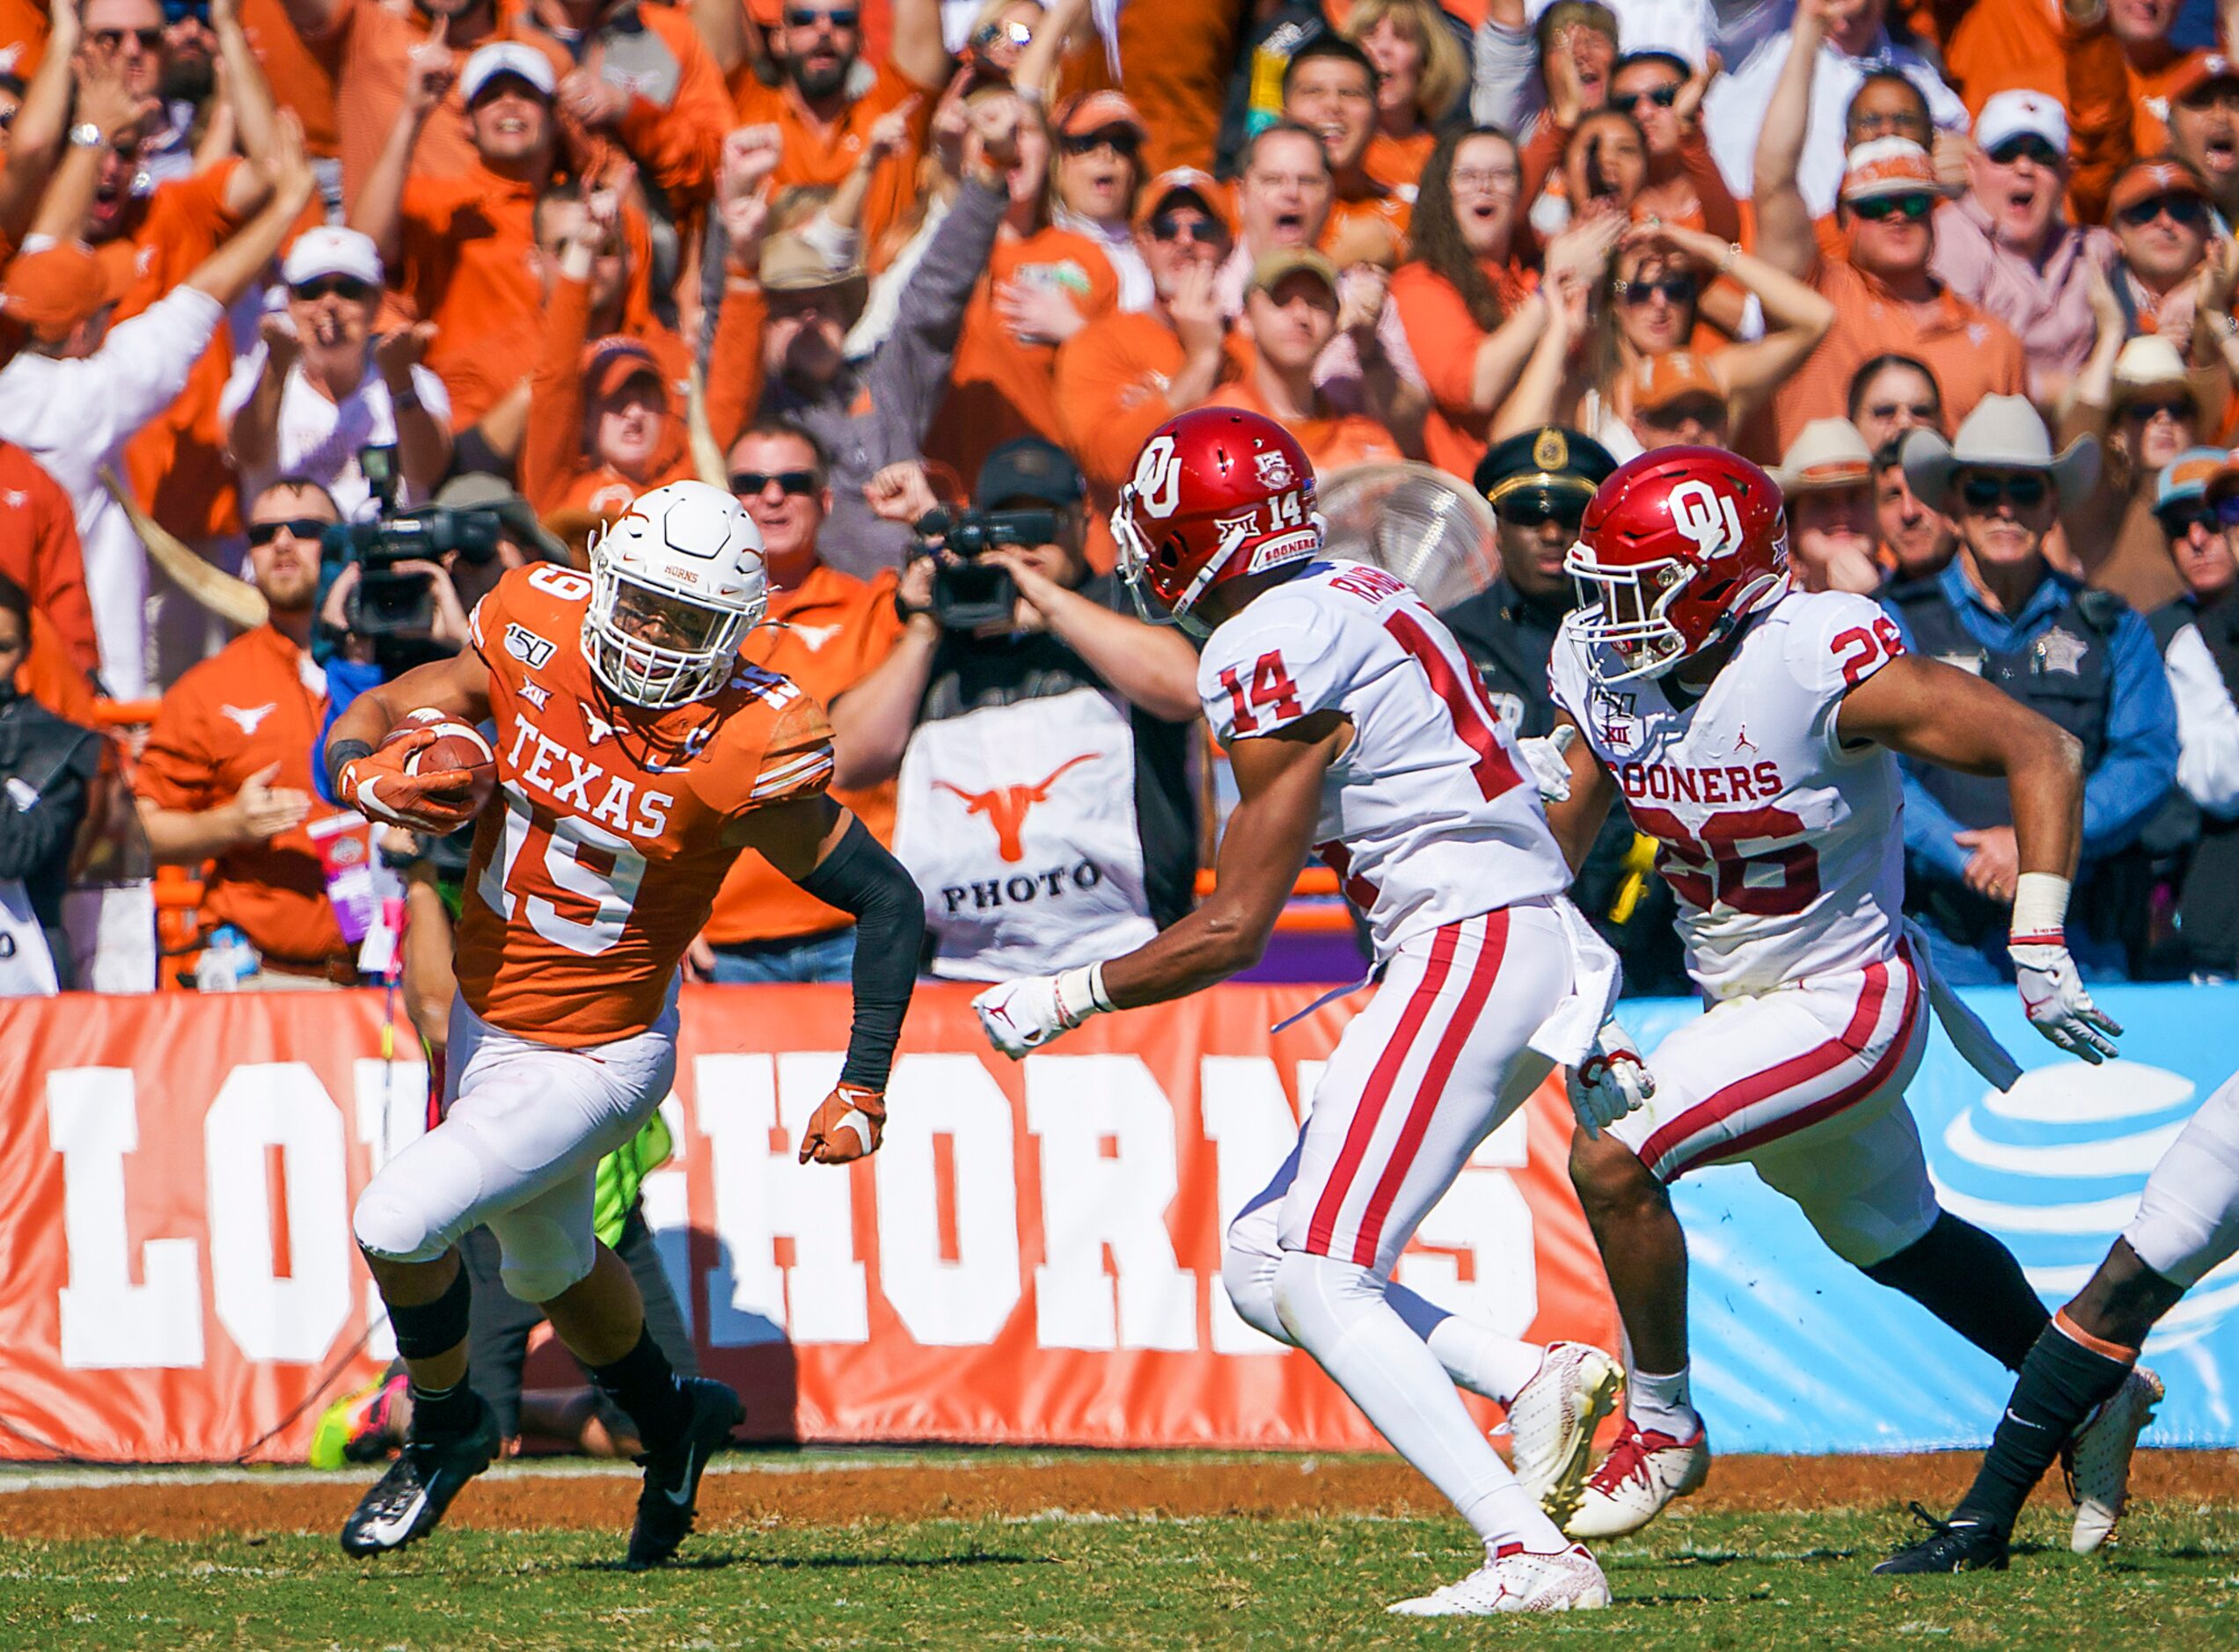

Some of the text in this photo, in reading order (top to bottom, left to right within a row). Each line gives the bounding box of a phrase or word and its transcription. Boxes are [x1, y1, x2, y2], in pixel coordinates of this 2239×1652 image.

[1135, 435, 1182, 519] OU
[1254, 449, 1287, 472] 125
[1268, 490, 1302, 532] 14
[1667, 479, 1744, 559] OU
[664, 564, 699, 583] HORNS
[1265, 537, 1316, 561] SOONERS
[506, 624, 555, 668] 150
[1219, 649, 1303, 734] 14
[1599, 724, 1632, 745] XII
[506, 713, 675, 838] TEXAS
[1605, 760, 1784, 804] OONERS
[477, 778, 648, 957] 19
[1628, 804, 1822, 917] 26
[941, 859, 1101, 913] PHOTO
